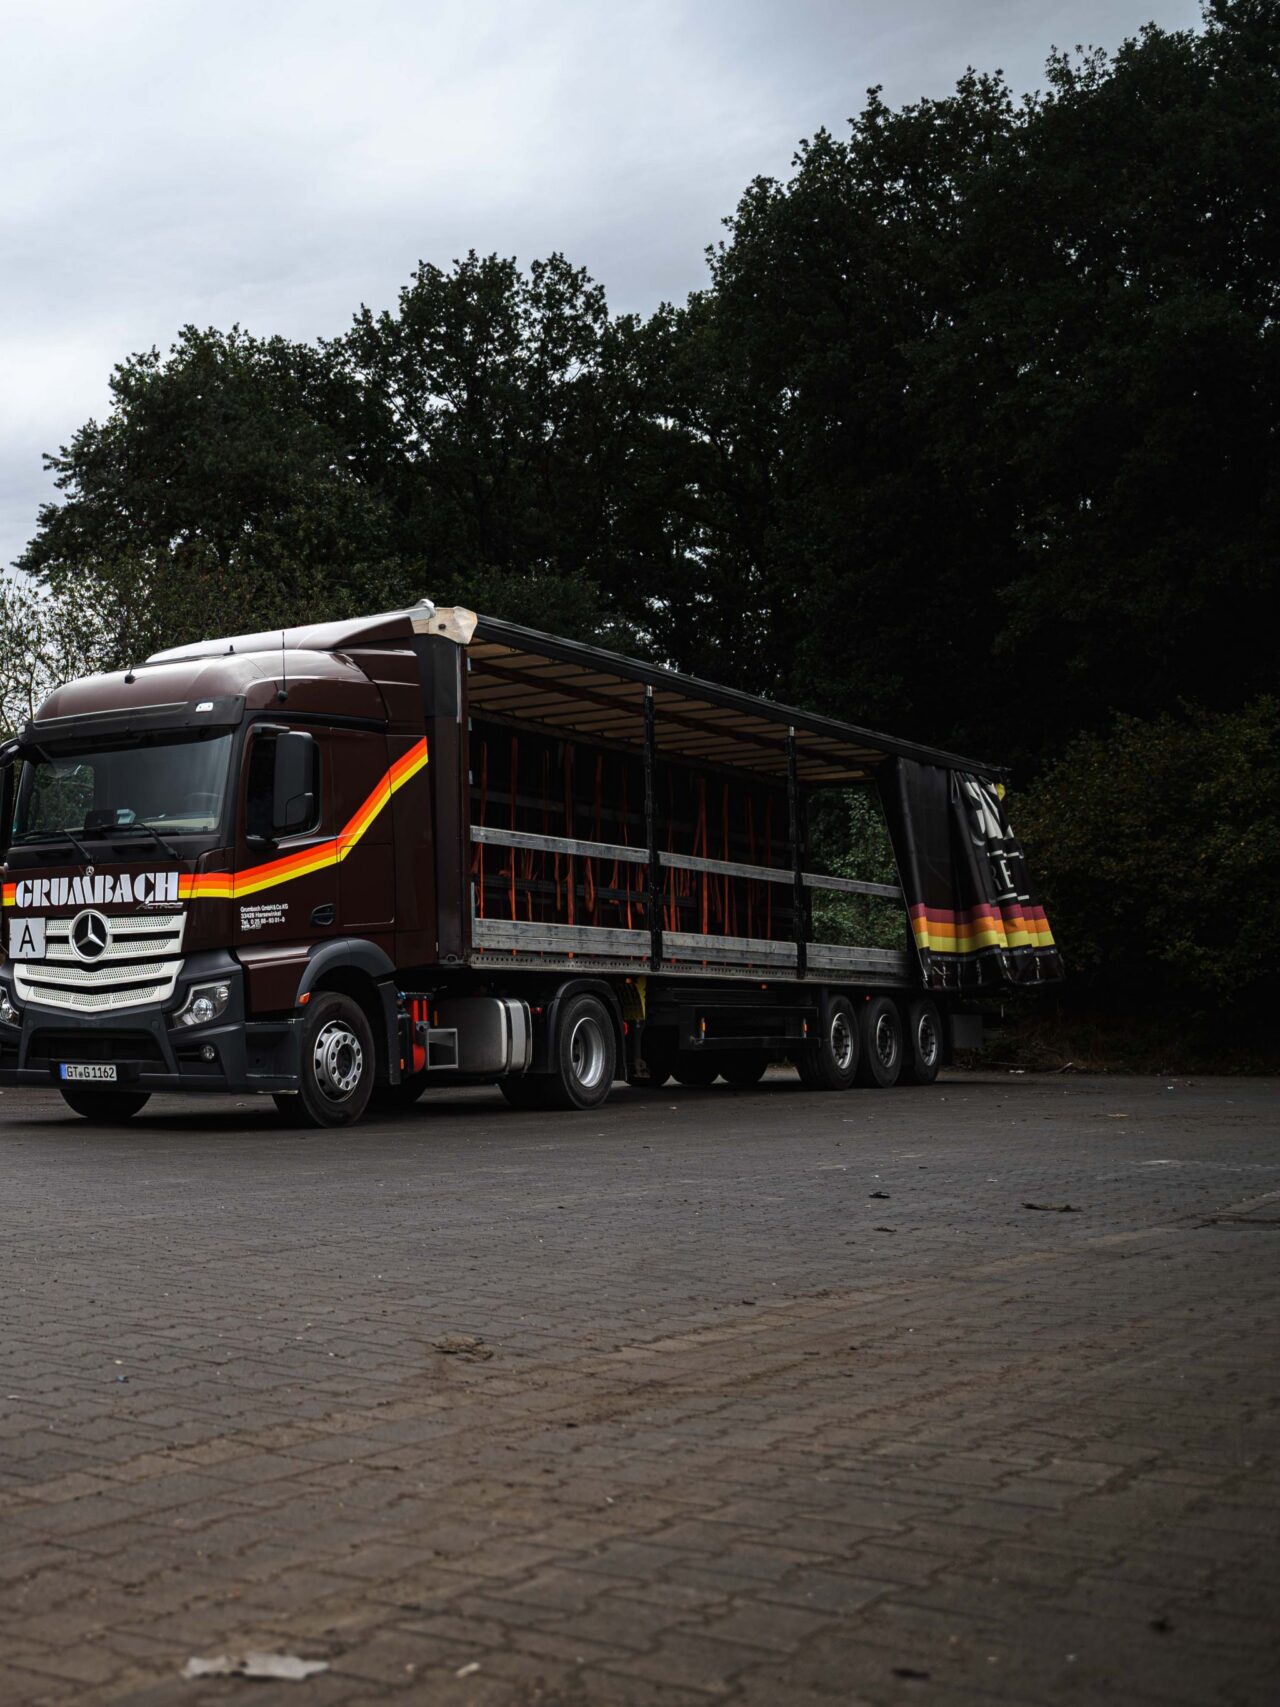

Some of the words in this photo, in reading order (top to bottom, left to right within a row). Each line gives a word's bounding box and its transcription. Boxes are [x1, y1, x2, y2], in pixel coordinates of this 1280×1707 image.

[16, 871, 178, 909] GRUMBACH
[19, 924, 36, 952] A
[67, 1065, 78, 1078] GT
